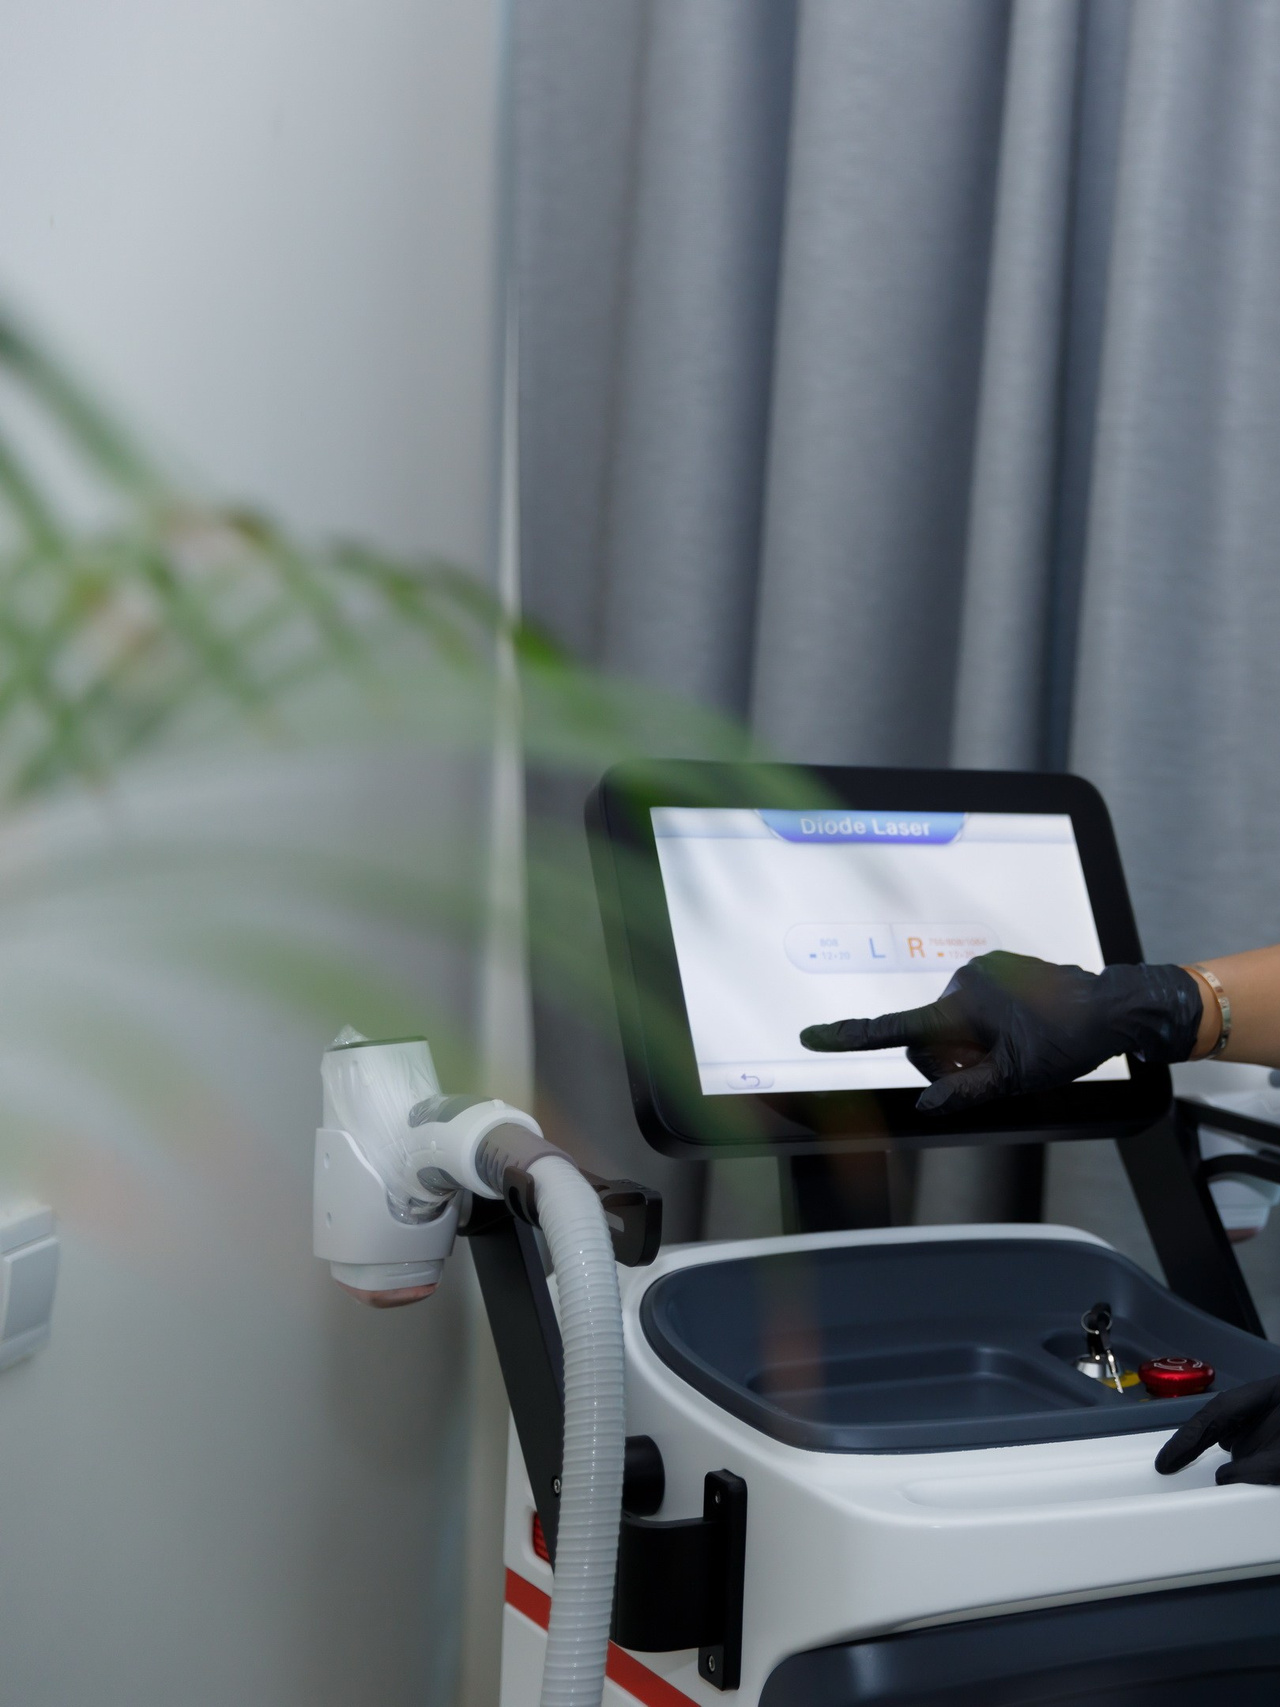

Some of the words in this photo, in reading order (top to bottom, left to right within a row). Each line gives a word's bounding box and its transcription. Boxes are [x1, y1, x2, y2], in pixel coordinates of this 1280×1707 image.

[800, 817, 866, 835] Diode
[871, 818, 932, 836] Laser
[868, 937, 886, 959] L
[907, 936, 926, 959] R
